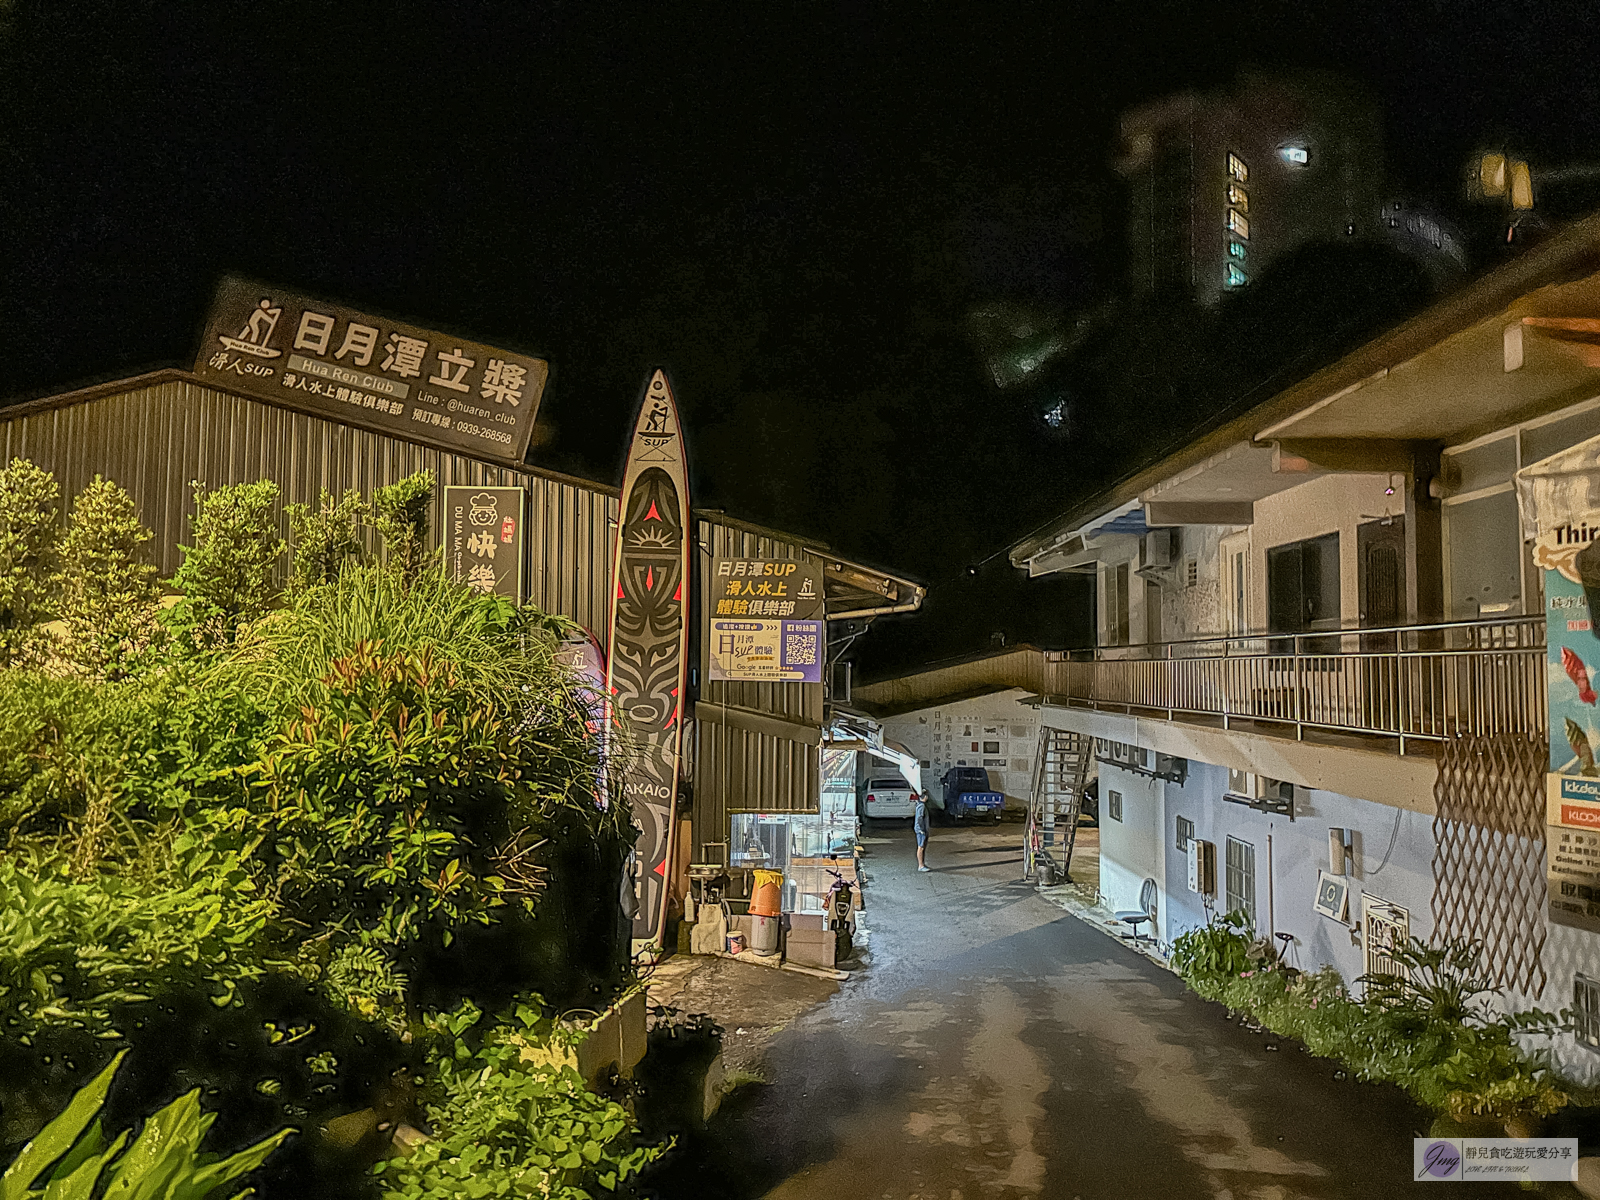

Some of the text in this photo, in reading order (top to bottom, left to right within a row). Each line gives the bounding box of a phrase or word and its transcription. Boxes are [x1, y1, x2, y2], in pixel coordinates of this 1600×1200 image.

[292, 310, 527, 407] 日月潭立槳
[302, 359, 394, 393] Hua Ren Club
[282, 372, 405, 416] 滑人水上體驗俱樂部
[447, 398, 516, 426] @huaren_club
[644, 438, 669, 447] SUP
[454, 506, 463, 519] DU
[454, 520, 463, 535] MA
[454, 537, 463, 551] MA
[726, 580, 788, 596] 滑人水上
[716, 599, 796, 616] 體驗俱樂部
